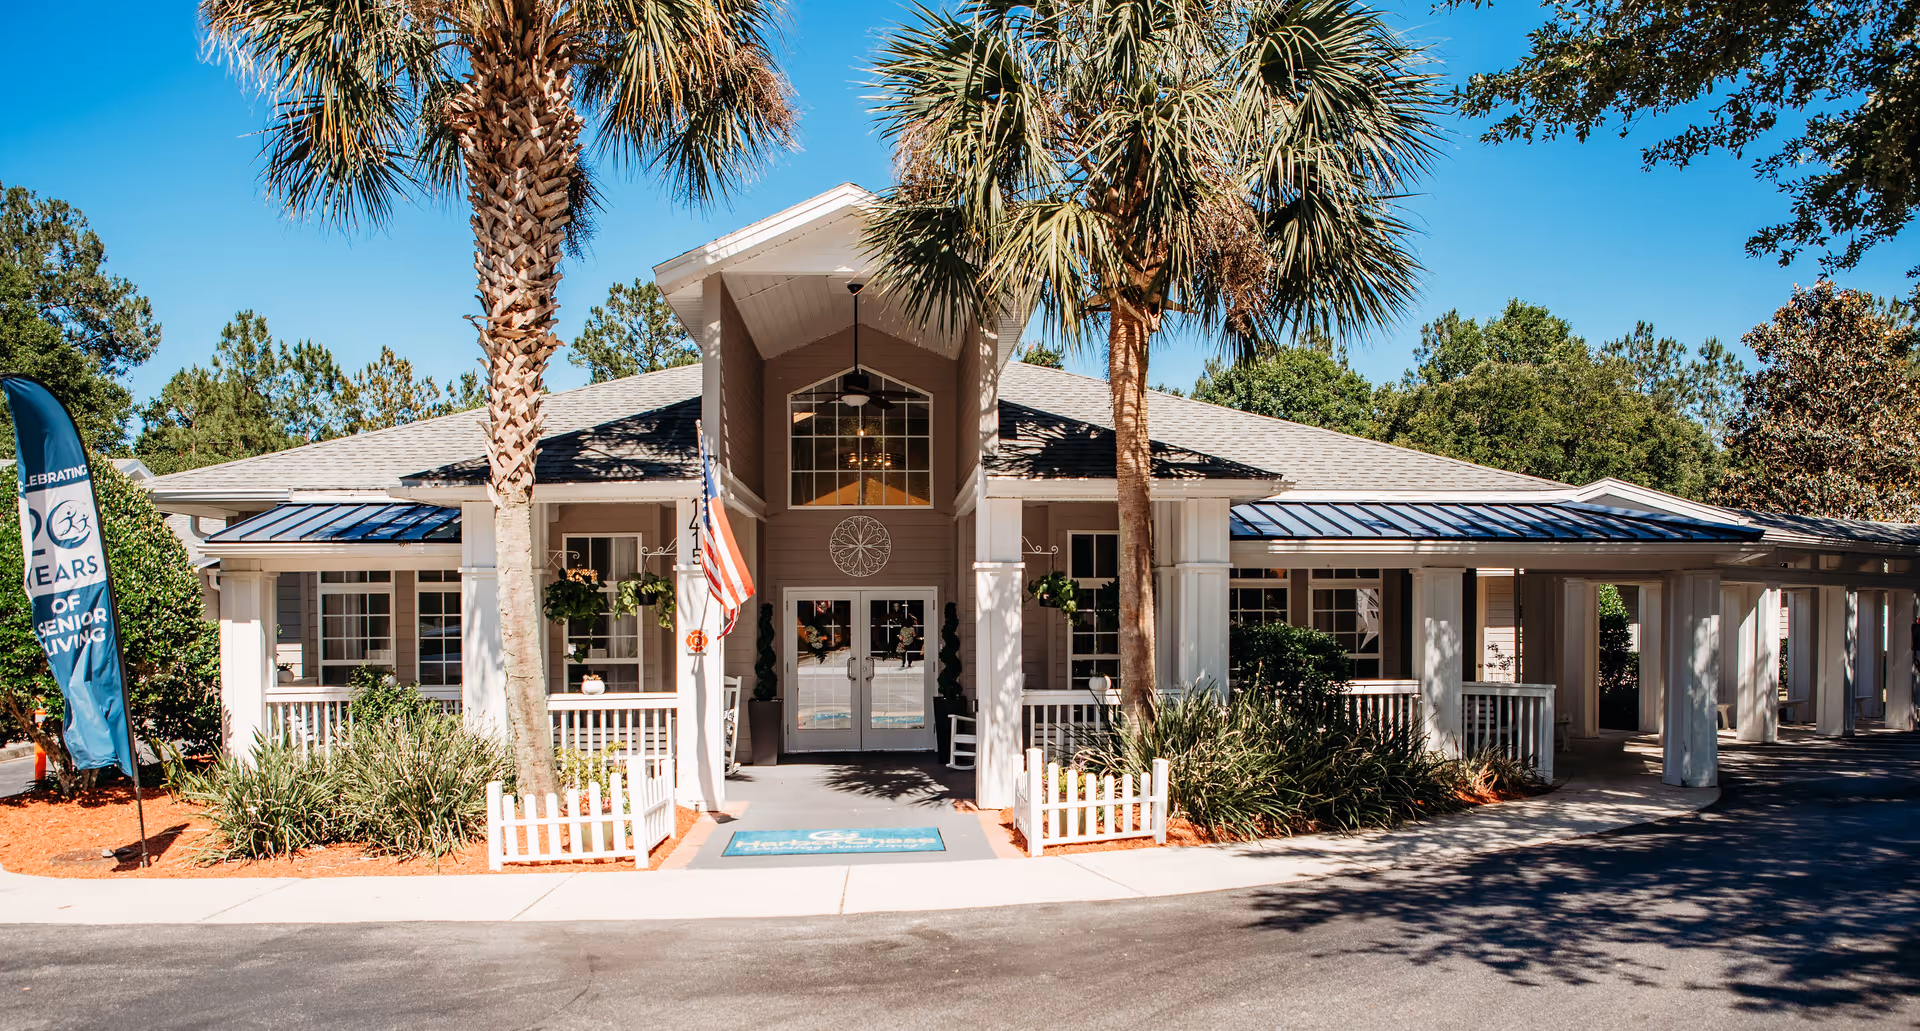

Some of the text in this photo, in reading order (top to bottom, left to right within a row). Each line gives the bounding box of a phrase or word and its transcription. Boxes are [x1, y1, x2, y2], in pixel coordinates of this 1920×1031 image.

[18, 464, 88, 493] CEBRATING
[689, 498, 701, 565] 1415
[51, 594, 81, 614] OF
[37, 607, 108, 639] SENIOR
[44, 627, 106, 657] LIVING
